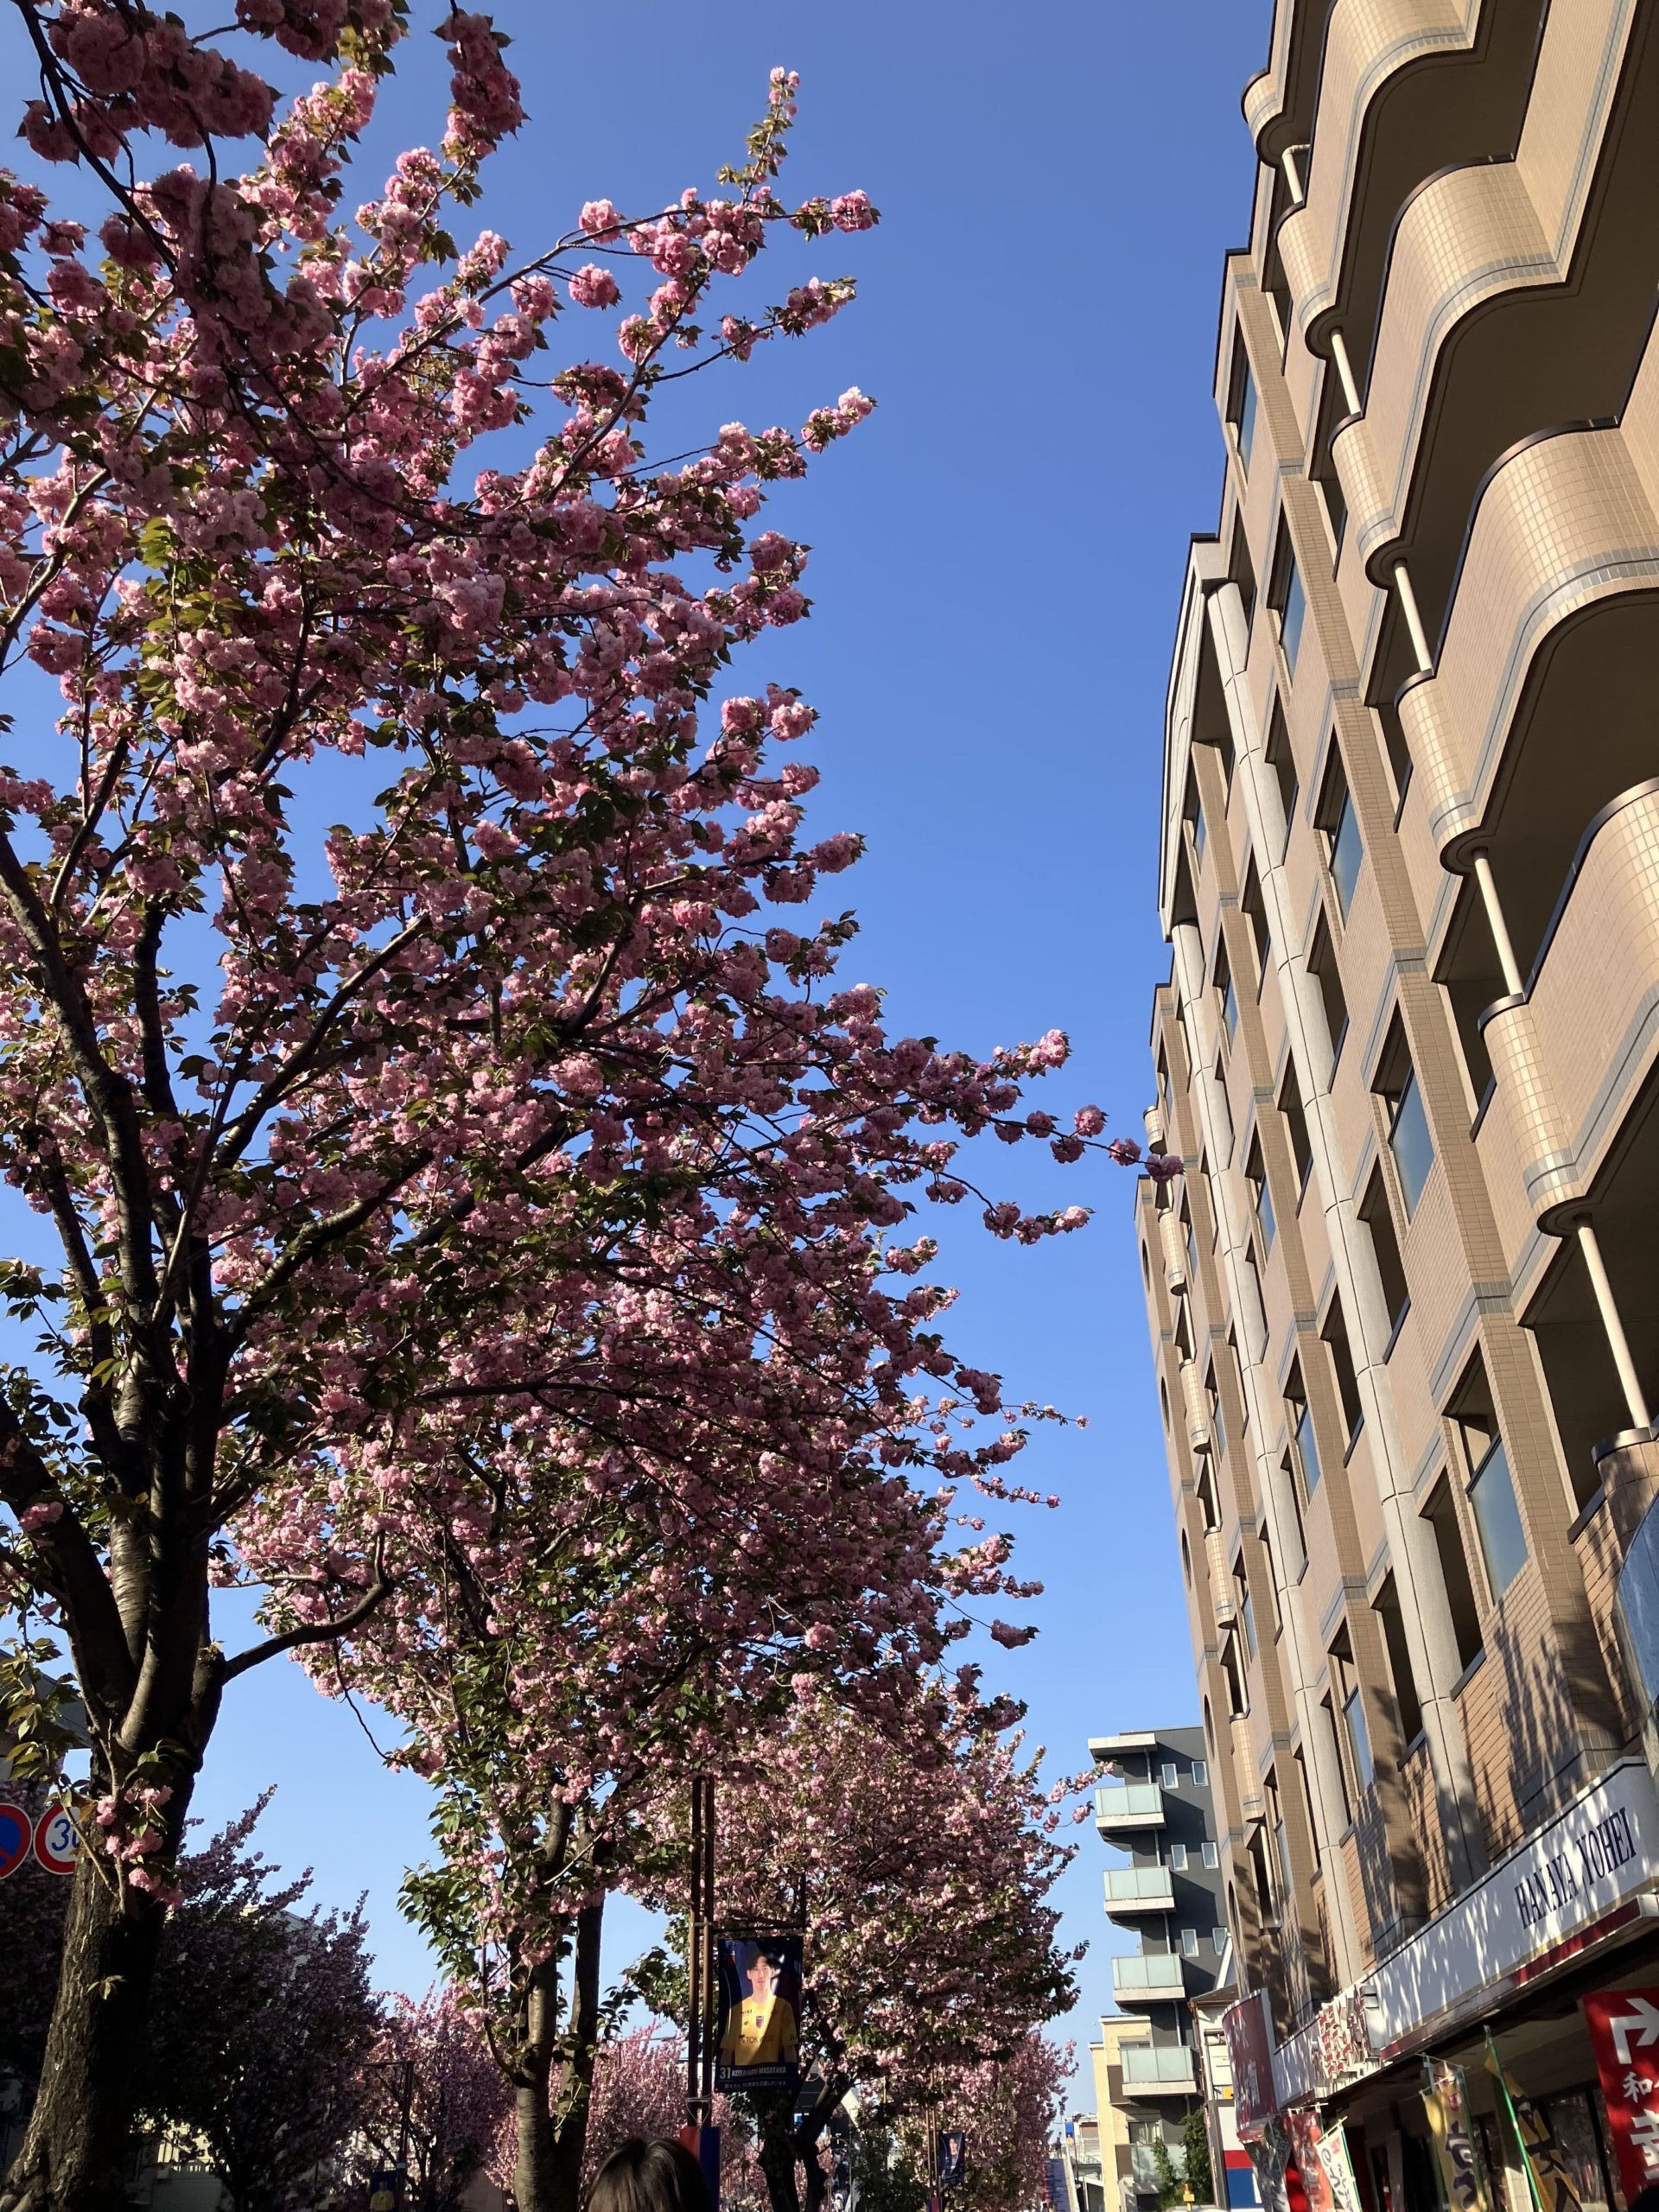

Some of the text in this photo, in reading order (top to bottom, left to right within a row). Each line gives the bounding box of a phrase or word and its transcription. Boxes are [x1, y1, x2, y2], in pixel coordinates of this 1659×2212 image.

[1514, 1807, 1637, 1929] HANAYA YOHEI
[719, 2066, 731, 2080] 31
[1622, 2071, 1659, 2104] 和
